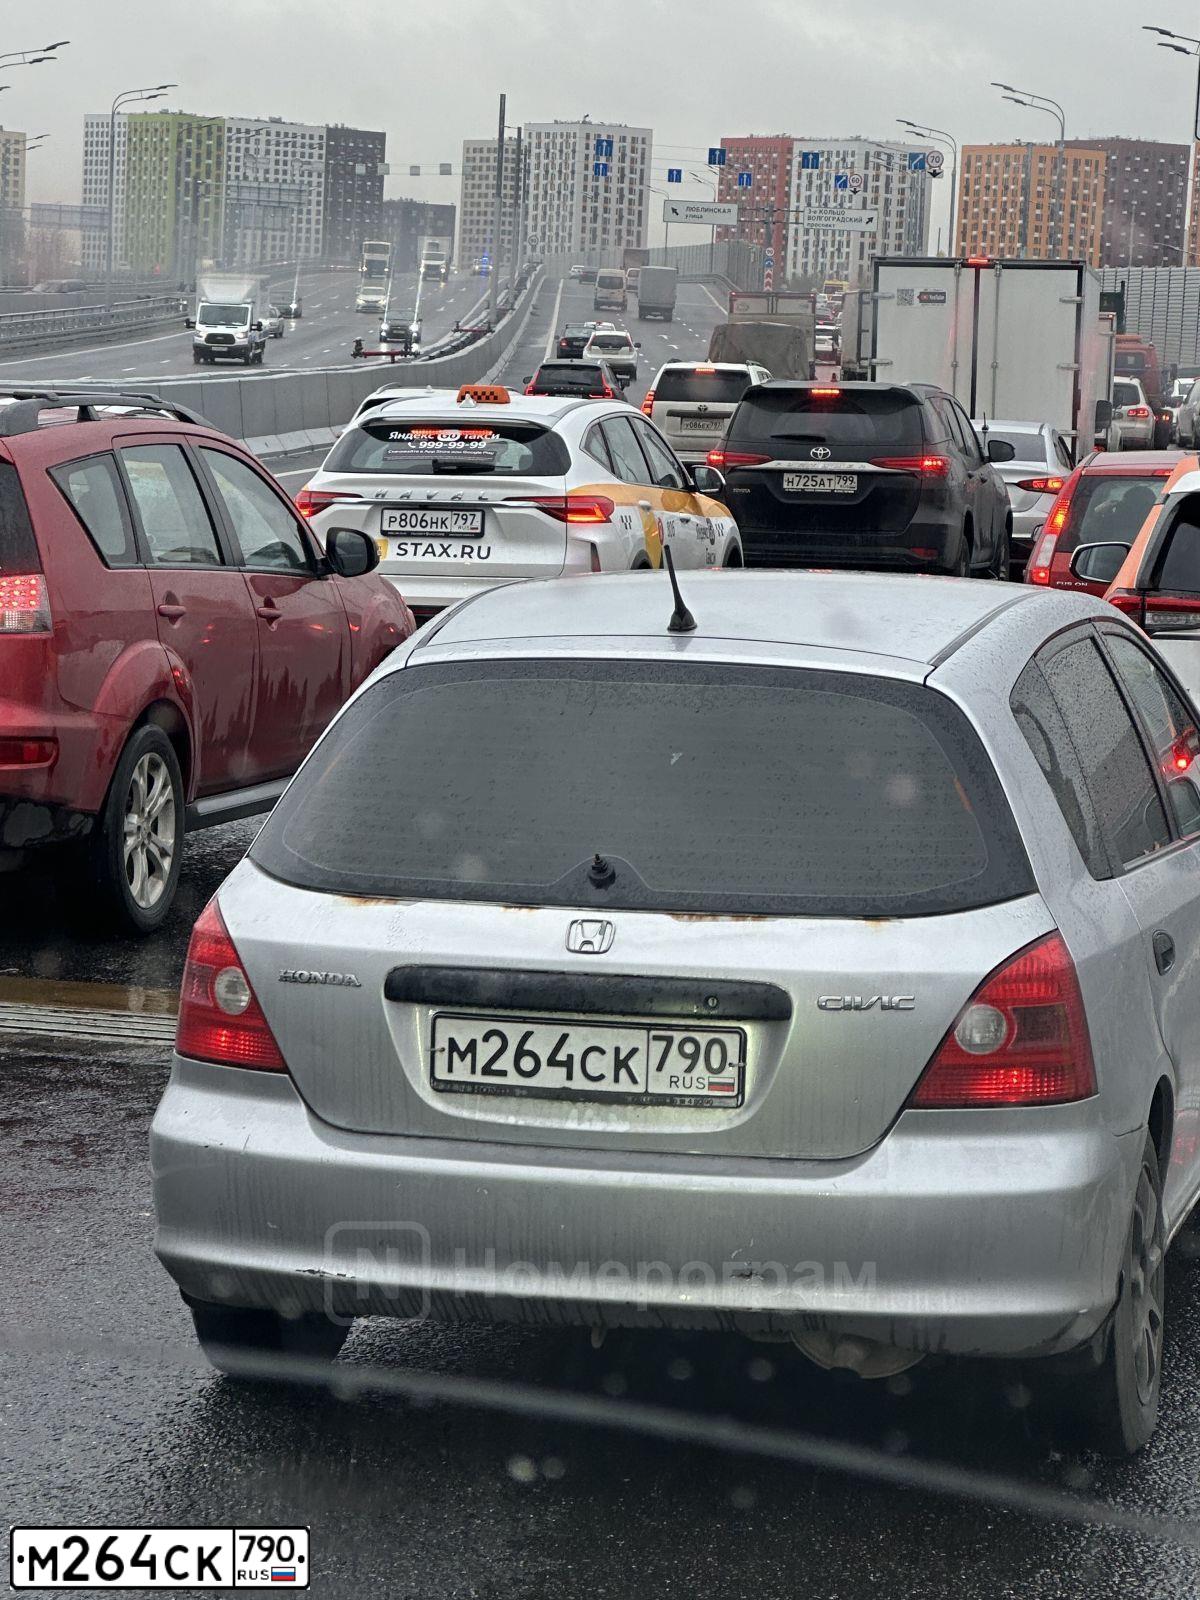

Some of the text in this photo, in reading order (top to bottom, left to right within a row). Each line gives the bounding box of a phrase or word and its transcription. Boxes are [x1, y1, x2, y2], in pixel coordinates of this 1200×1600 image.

[930, 155, 941, 164] 70
[851, 176, 860, 184] 60
[685, 206, 732, 214] ЛЮБЛИНСКАЯ
[807, 215, 863, 223] ВОЛГОГРАДСКИЙ
[389, 431, 435, 440] Яндекс
[418, 441, 487, 449] 999-99-99
[786, 475, 834, 488] Н725АТ
[836, 475, 855, 485] 799
[375, 489, 488, 500] HAVAL
[388, 512, 477, 530] Р806НК 797
[396, 542, 491, 560] STAX.RU
[279, 969, 362, 987] HONDA
[817, 995, 915, 1011] CIVIC
[447, 1029, 728, 1085] М264СК 790
[669, 1075, 707, 1090] RUS
